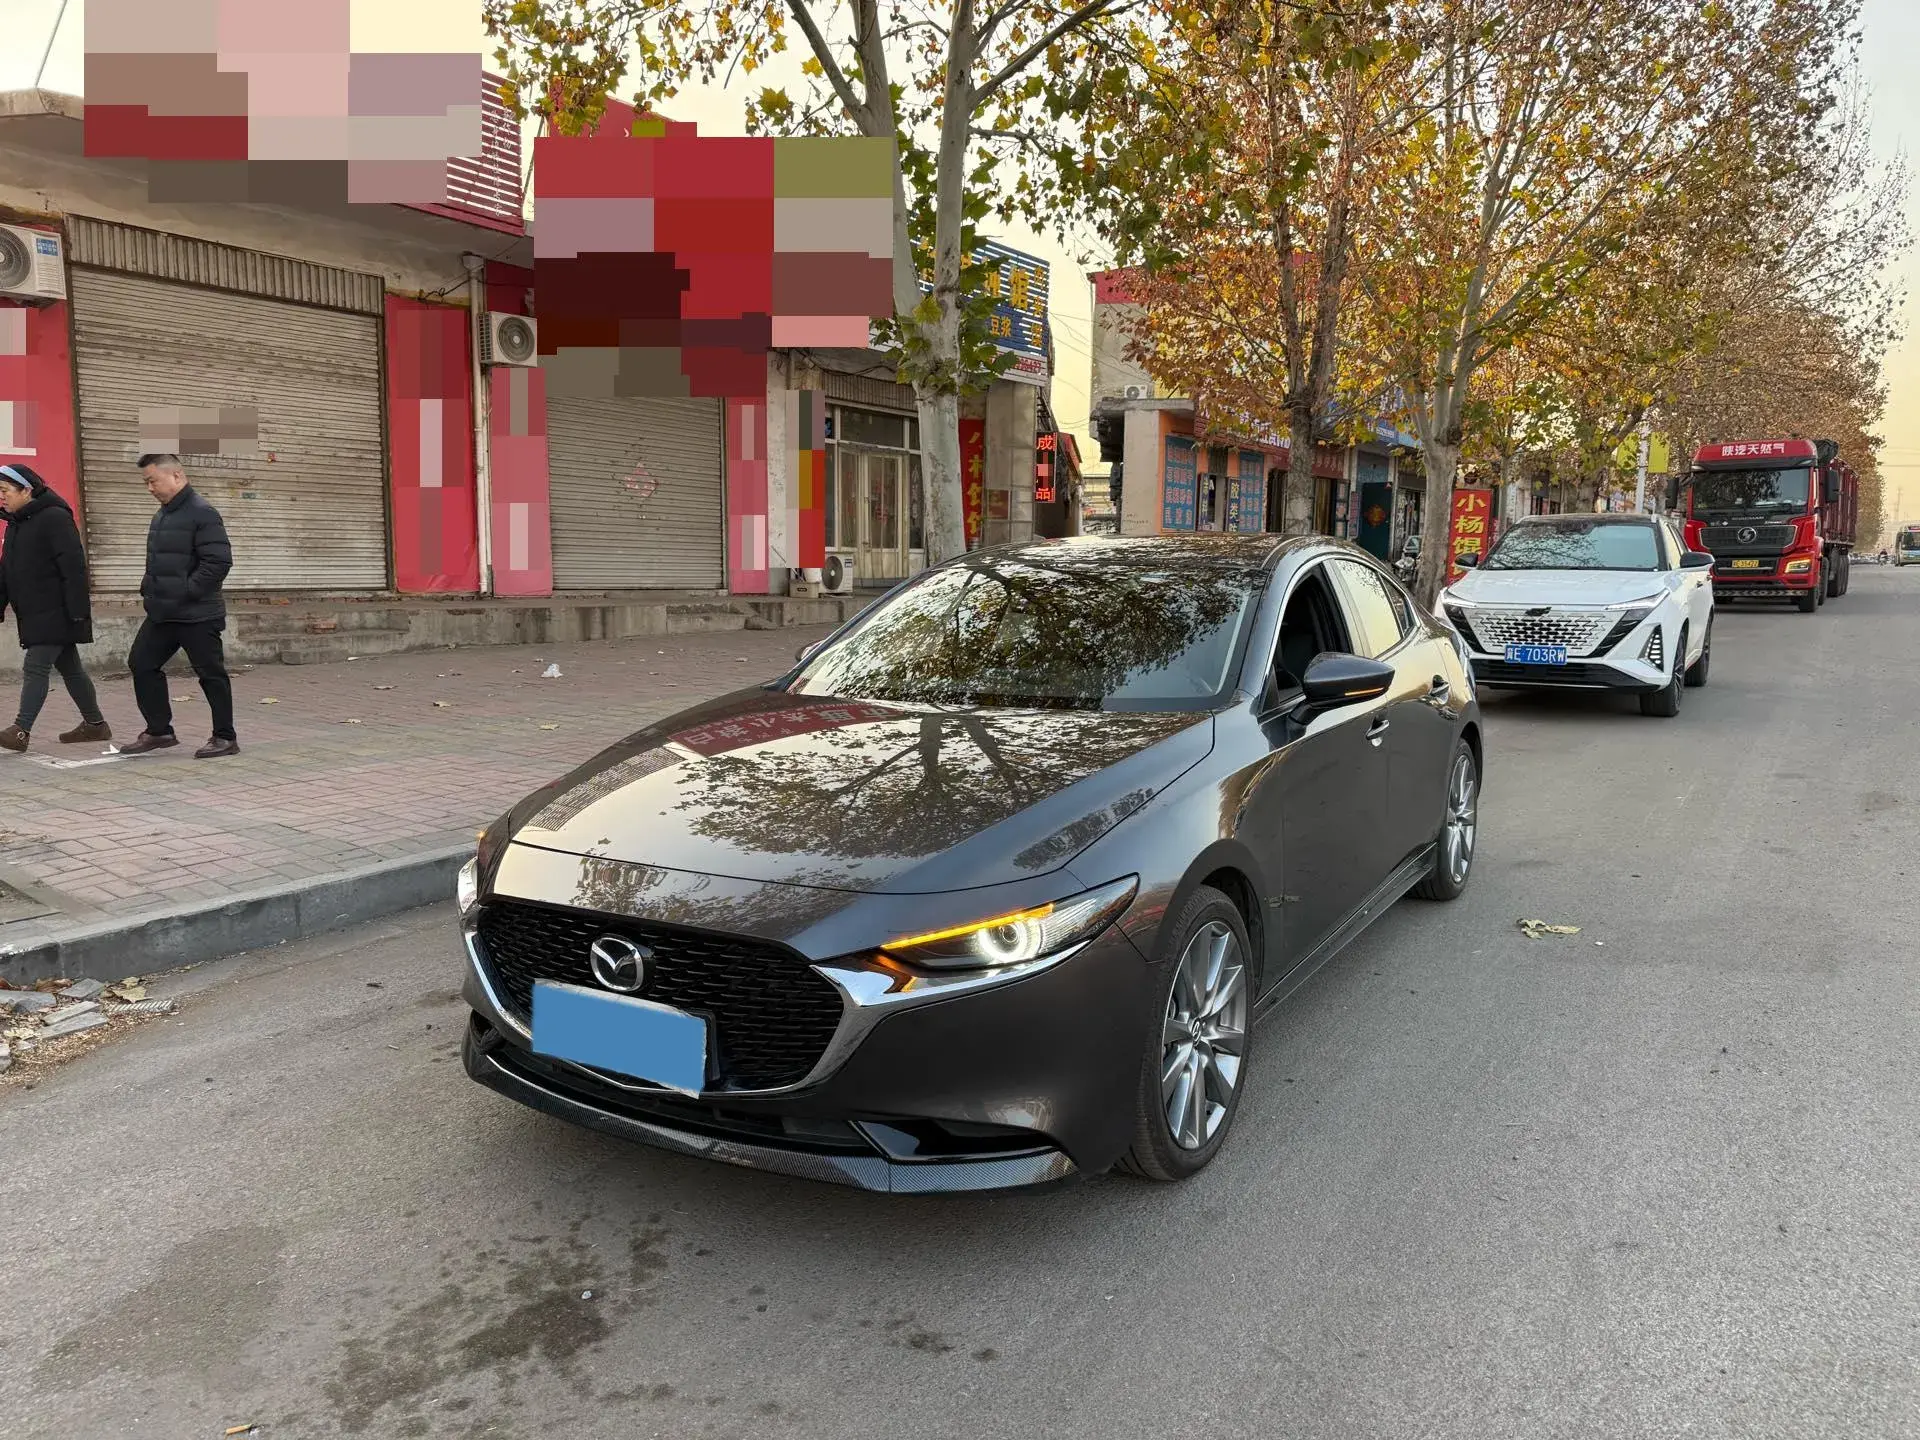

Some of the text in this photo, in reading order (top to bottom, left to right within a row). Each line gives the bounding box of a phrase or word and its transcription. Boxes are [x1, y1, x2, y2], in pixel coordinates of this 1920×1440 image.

[1721, 442, 1786, 457] 陕汽天然气
